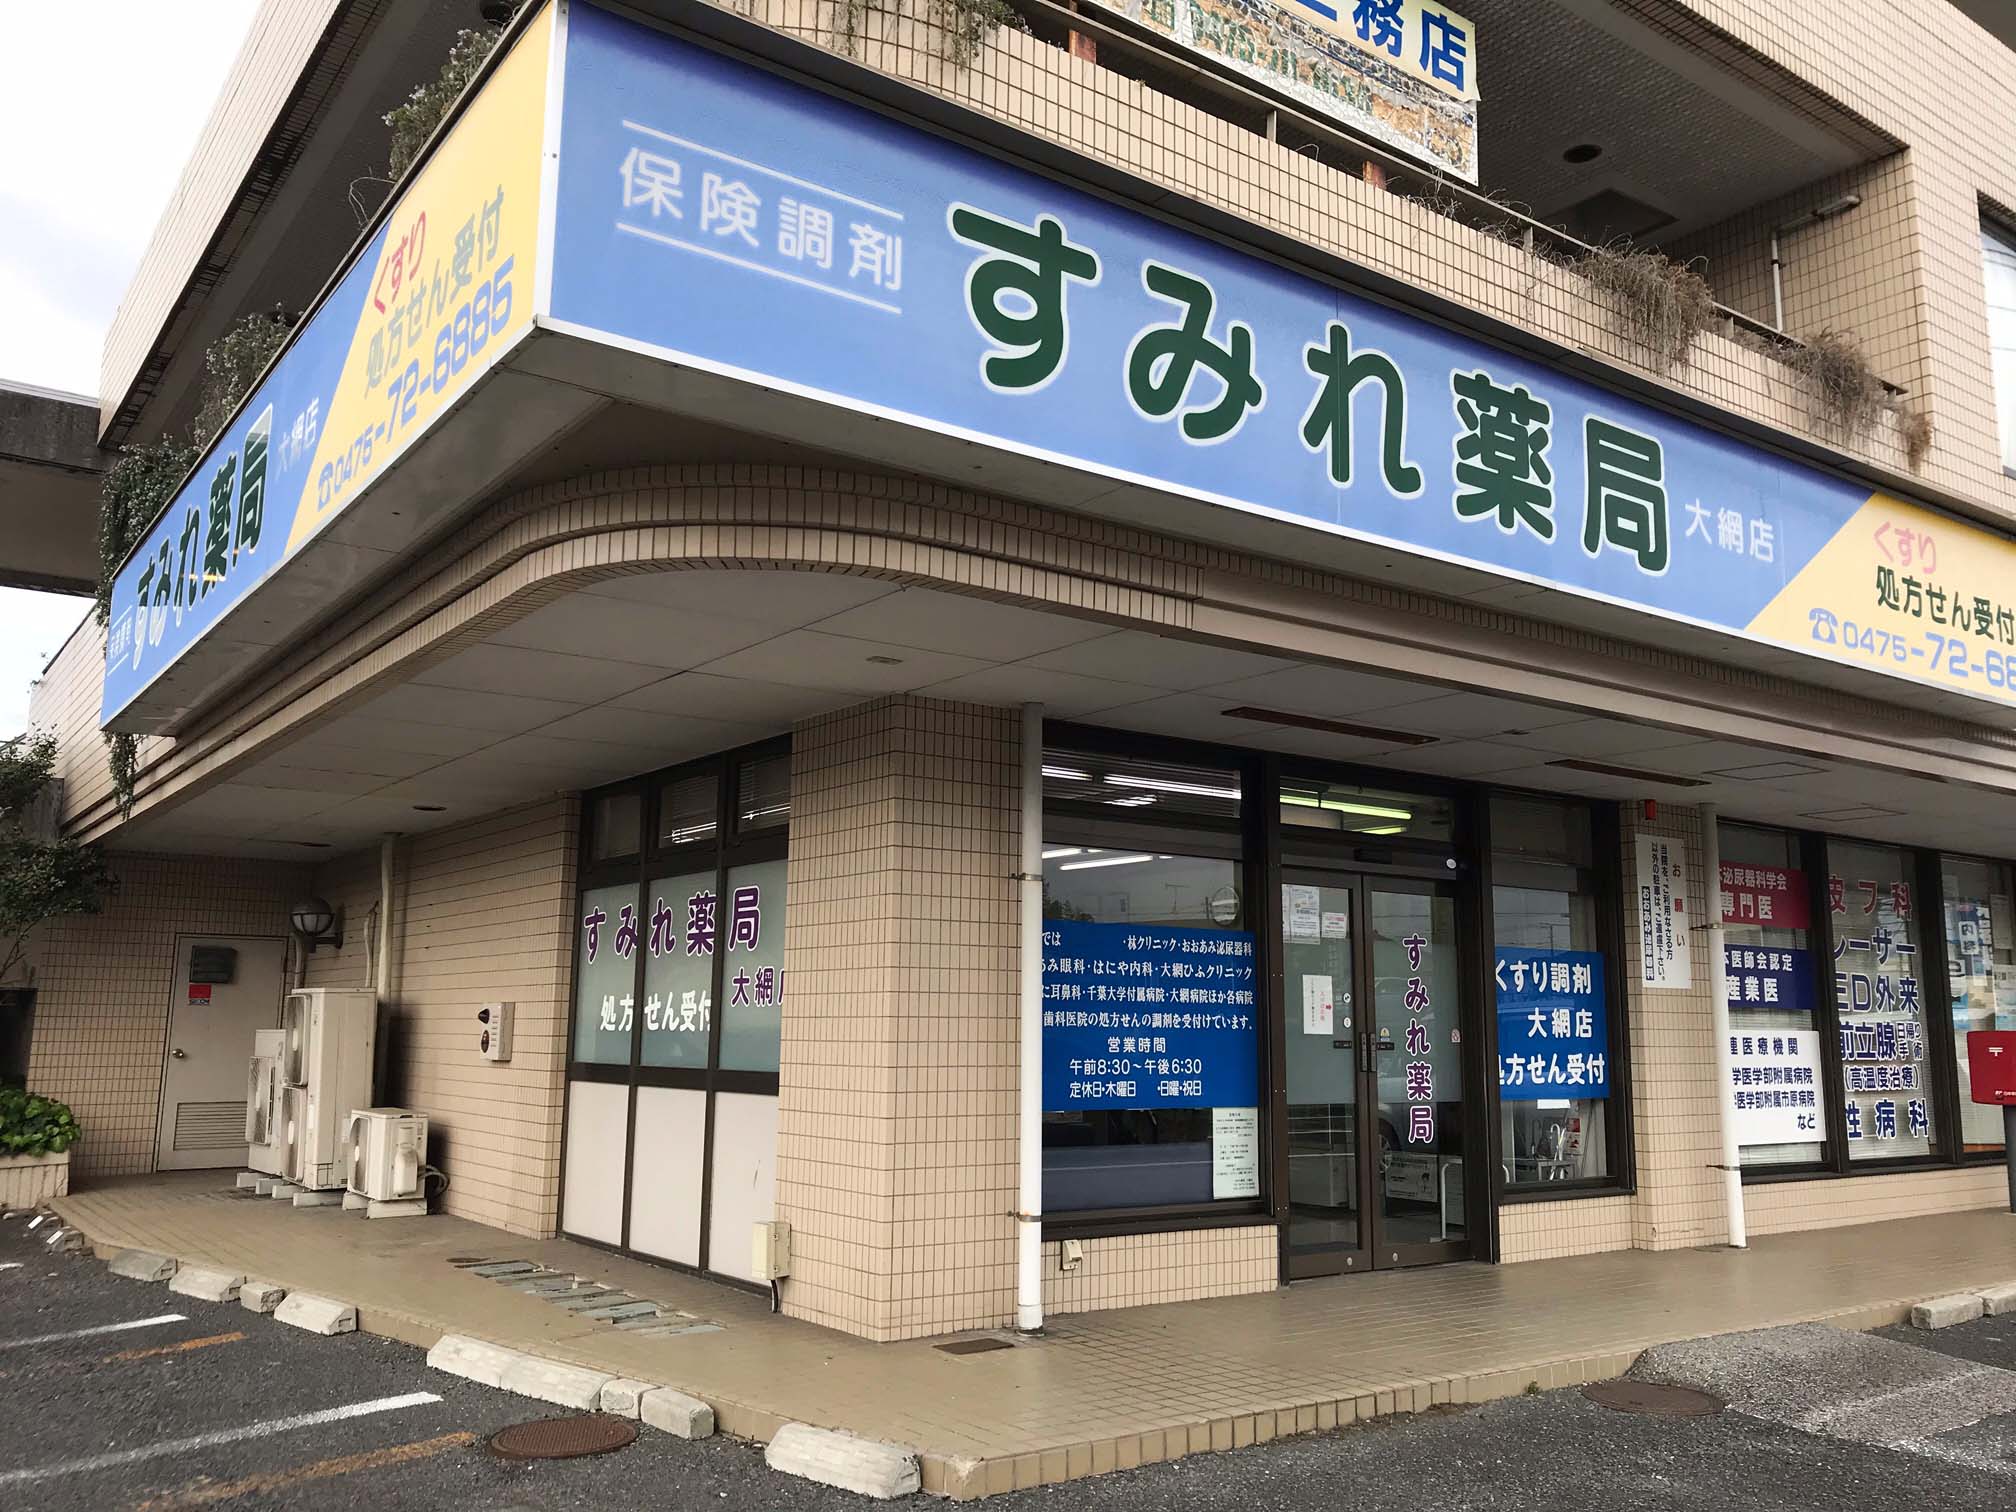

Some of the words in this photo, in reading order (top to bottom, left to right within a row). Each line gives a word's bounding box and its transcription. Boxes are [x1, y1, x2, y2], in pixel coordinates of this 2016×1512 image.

[1296, 0, 1467, 92] 務店
[618, 145, 904, 290] 保険調剤
[364, 183, 504, 400] 処方せん受付
[374, 211, 426, 315] くすり
[333, 254, 514, 495] 0475-72-6885
[946, 202, 1671, 576] すみれ薬局
[132, 402, 273, 671] すみれ薬局
[1685, 500, 1776, 565] 大網店
[1874, 521, 1937, 574] くすり
[1876, 565, 2015, 646] 処方せん受付
[1719, 867, 1787, 891] 泌尿器科学会
[1720, 890, 1773, 920] 専門医
[584, 885, 761, 964] すみれ薬局
[731, 966, 784, 1007] 大網
[1495, 959, 1592, 994] くすり調剤
[1726, 975, 1779, 1003] 産業医
[1107, 1036, 1166, 1053] 営業時間
[1403, 932, 1433, 1144] すみれ薬局
[1527, 1007, 1593, 1038] 大網店
[1069, 1081, 1136, 1098] 定休日・木曜日
[1734, 1090, 1815, 1109] 医学部附属市原病院
[1797, 1112, 1816, 1130] など
